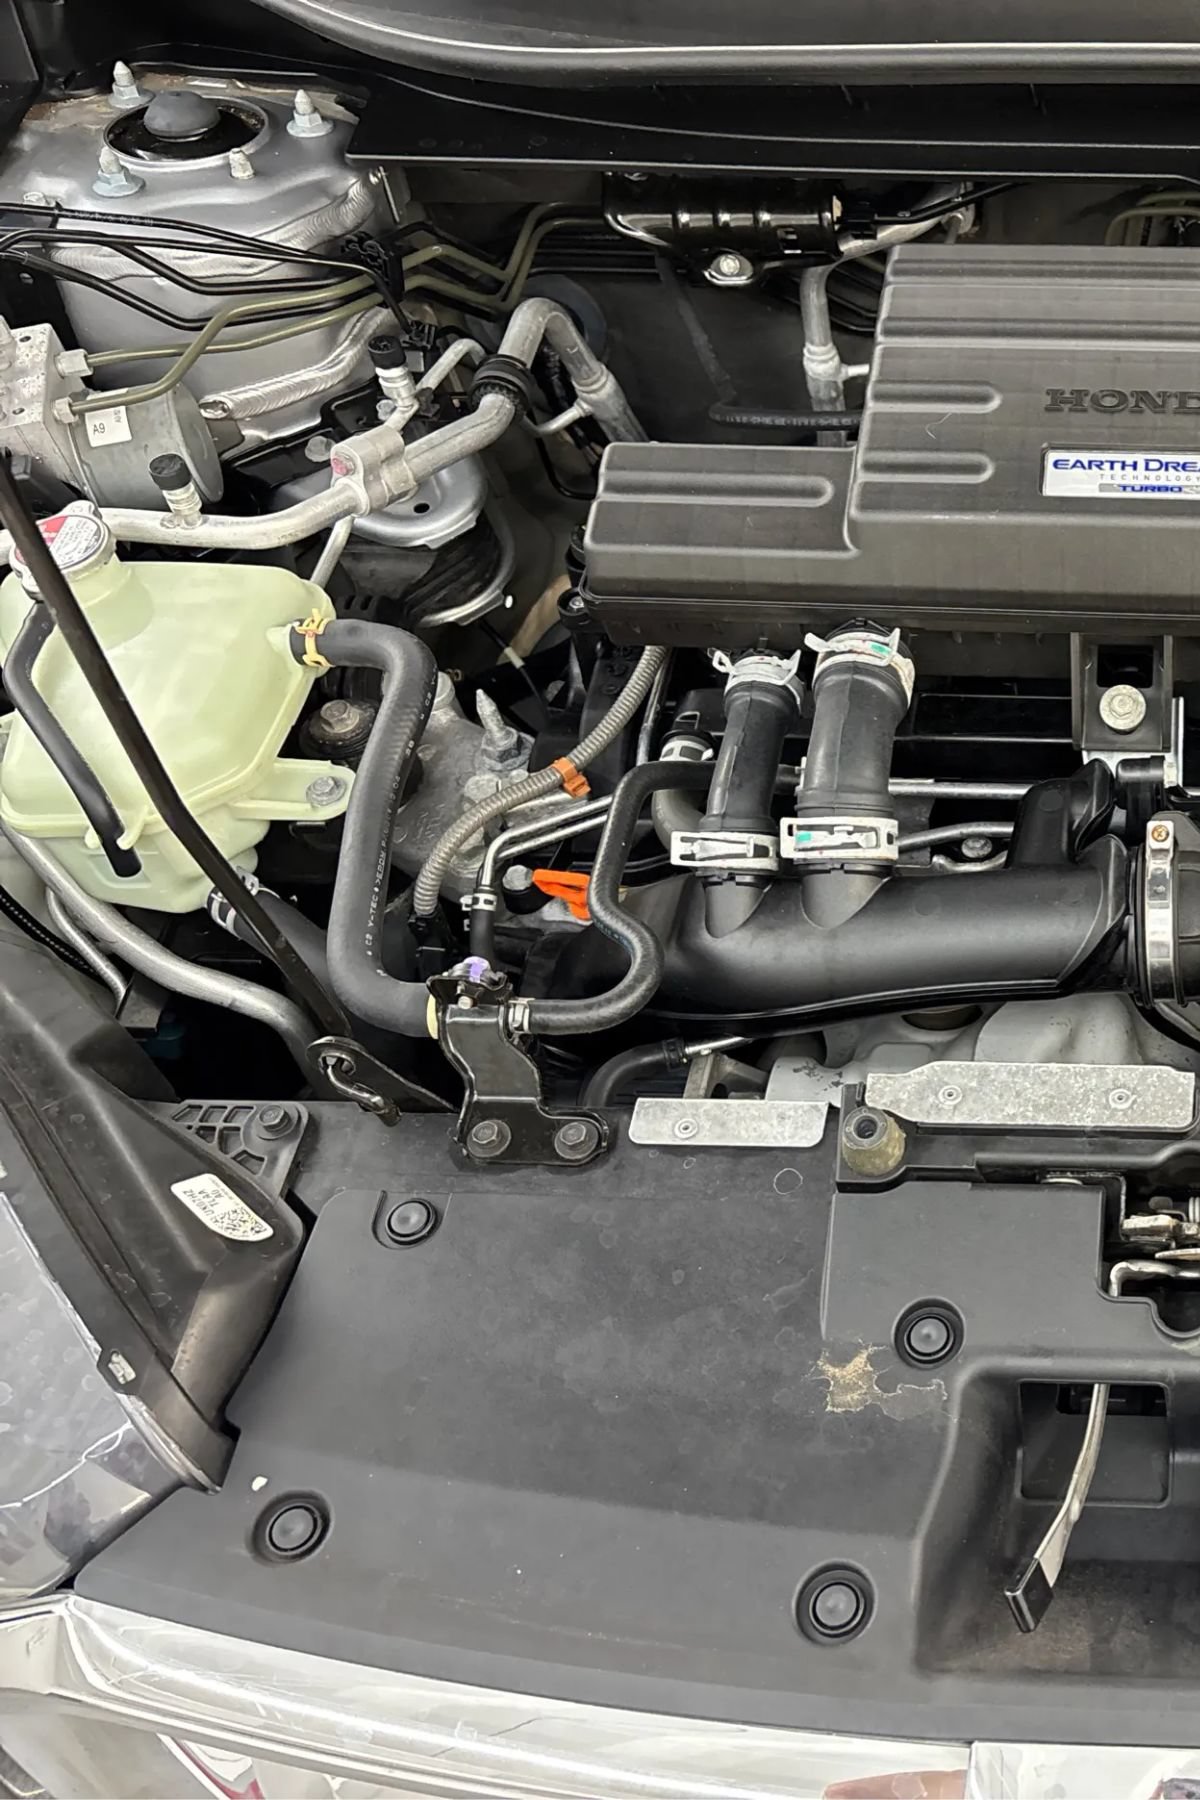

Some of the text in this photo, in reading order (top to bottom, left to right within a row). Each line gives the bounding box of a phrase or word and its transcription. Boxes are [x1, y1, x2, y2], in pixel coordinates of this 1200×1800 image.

[93, 422, 106, 435] A9
[1053, 459, 1138, 472] EARTH
[1100, 474, 1200, 482] TECHNOLOGY
[1118, 485, 1183, 493] TURBO
